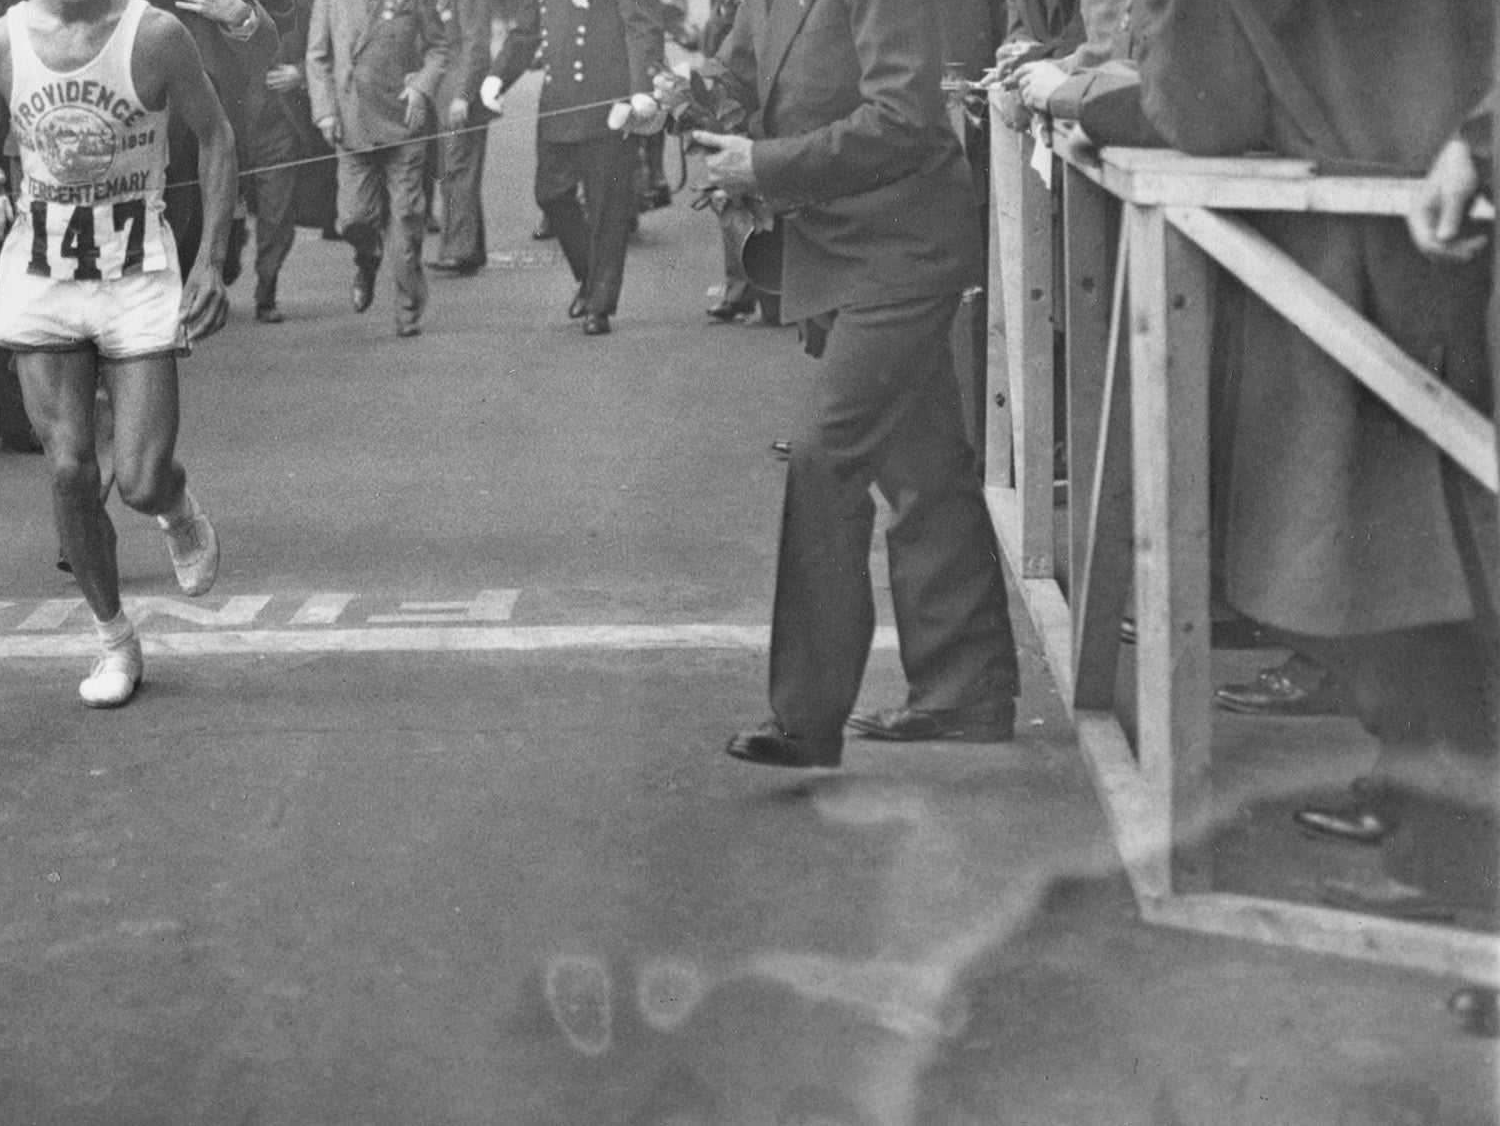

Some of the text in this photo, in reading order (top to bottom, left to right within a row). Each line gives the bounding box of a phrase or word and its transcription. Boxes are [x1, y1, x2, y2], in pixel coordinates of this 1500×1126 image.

[13, 80, 146, 131] PROVIDENCE
[29, 169, 150, 204] TERCENTENARY
[26, 200, 146, 280] 147
